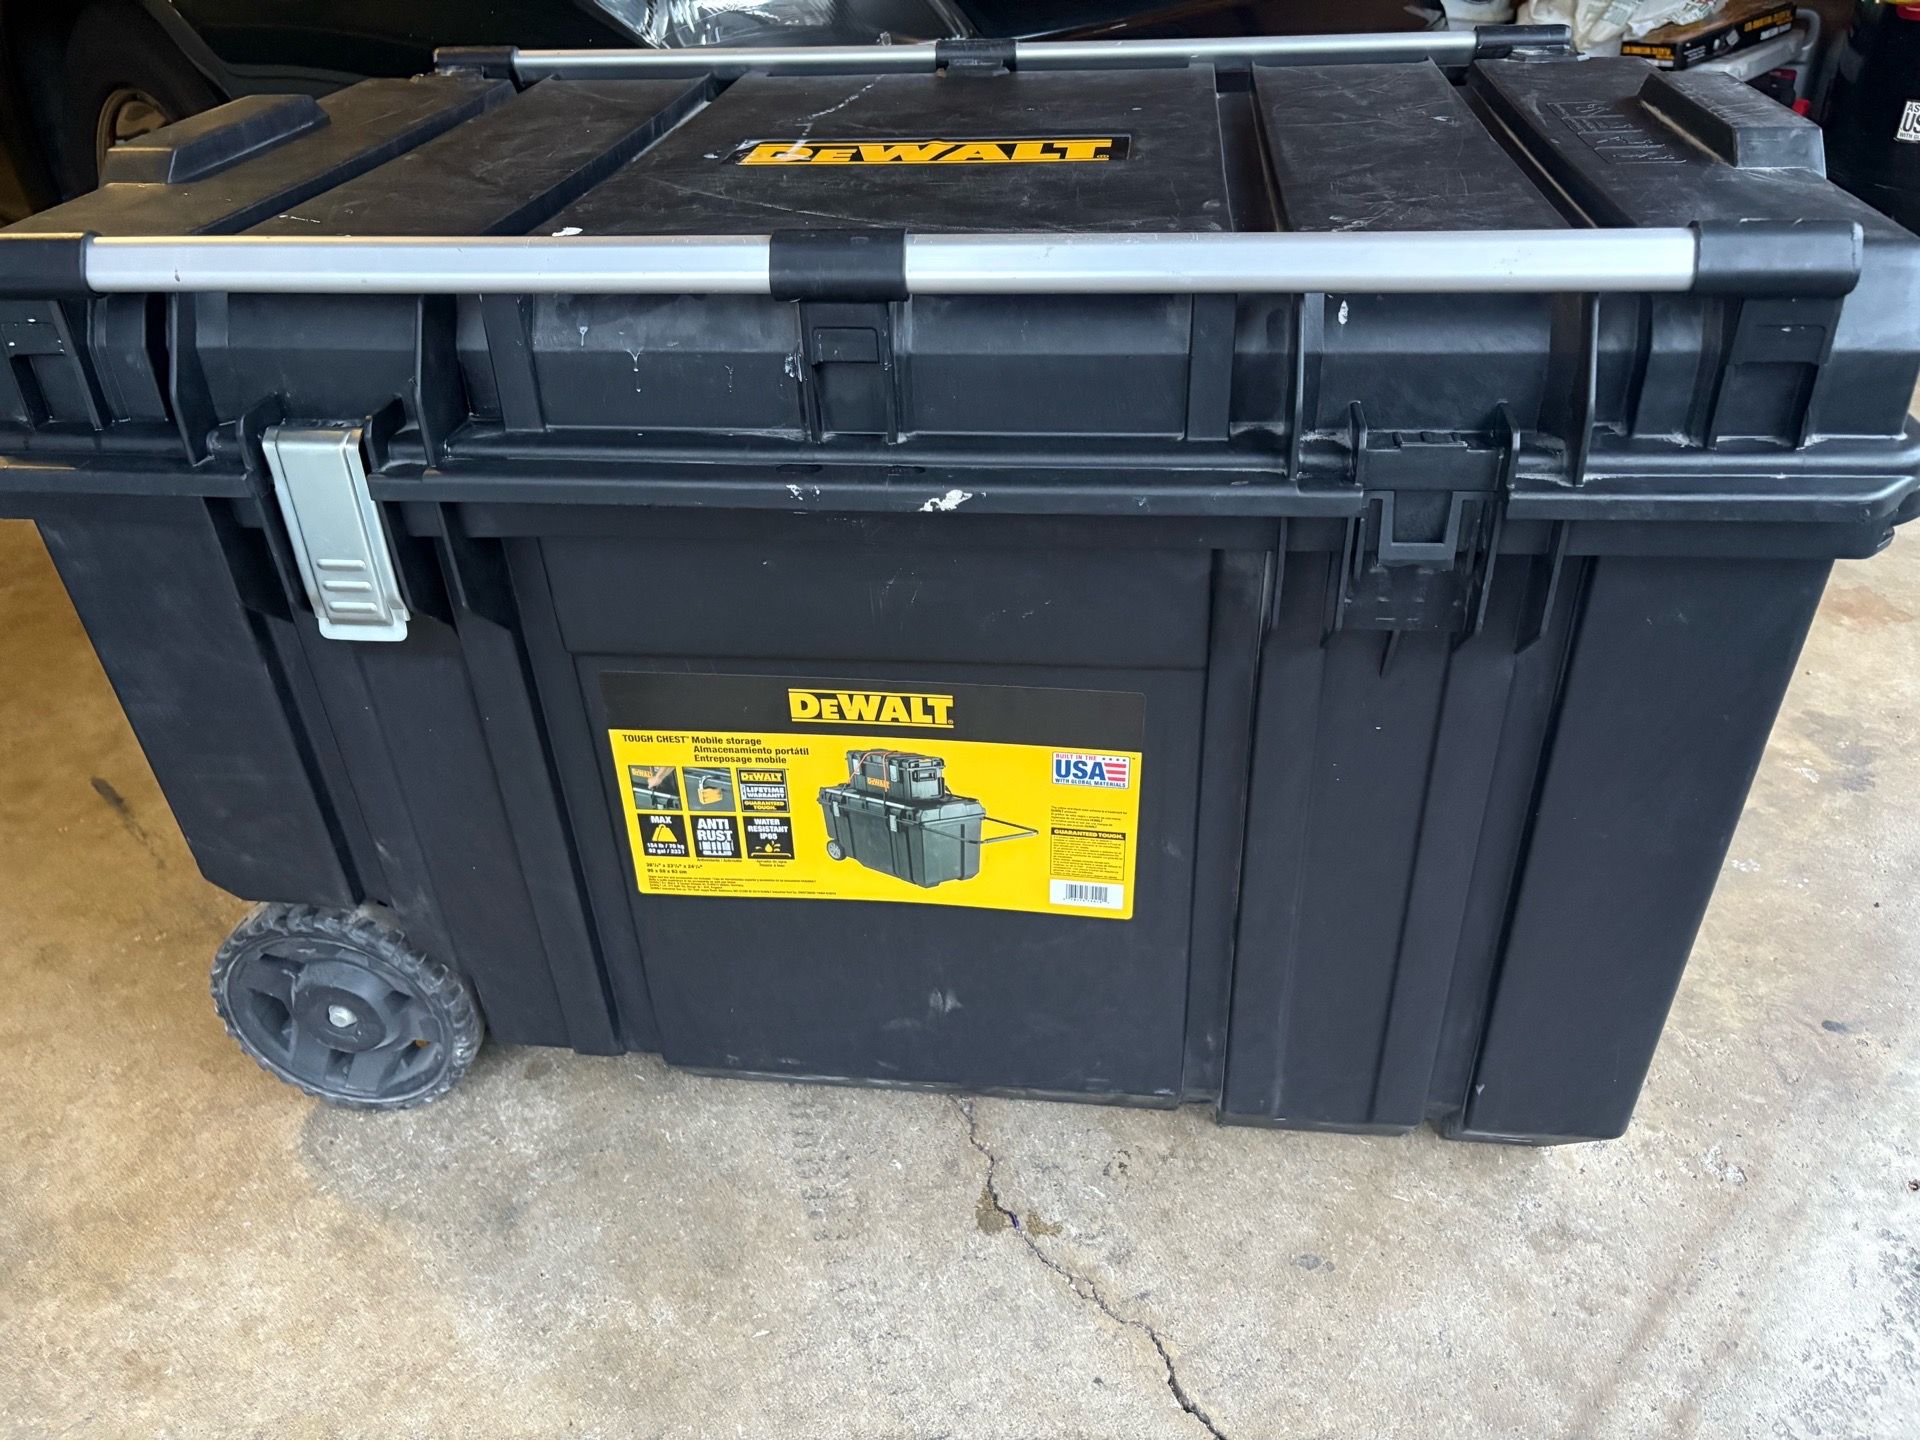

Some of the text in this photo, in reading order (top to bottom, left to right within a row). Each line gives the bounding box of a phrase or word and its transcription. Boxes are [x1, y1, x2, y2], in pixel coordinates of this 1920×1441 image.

[622, 734, 653, 743] TOUGH
[691, 736, 723, 745] Mobile
[726, 737, 762, 746] storage
[693, 745, 809, 756] Almacenamiento portátil
[694, 755, 787, 764] Entreposage mobile
[1055, 759, 1106, 780] USA
[650, 816, 672, 824] MAX
[697, 818, 729, 830] ANTI
[747, 825, 789, 833] RESISTANT
[1053, 829, 1097, 837] GUARANTEED
[696, 830, 733, 841] RUST
